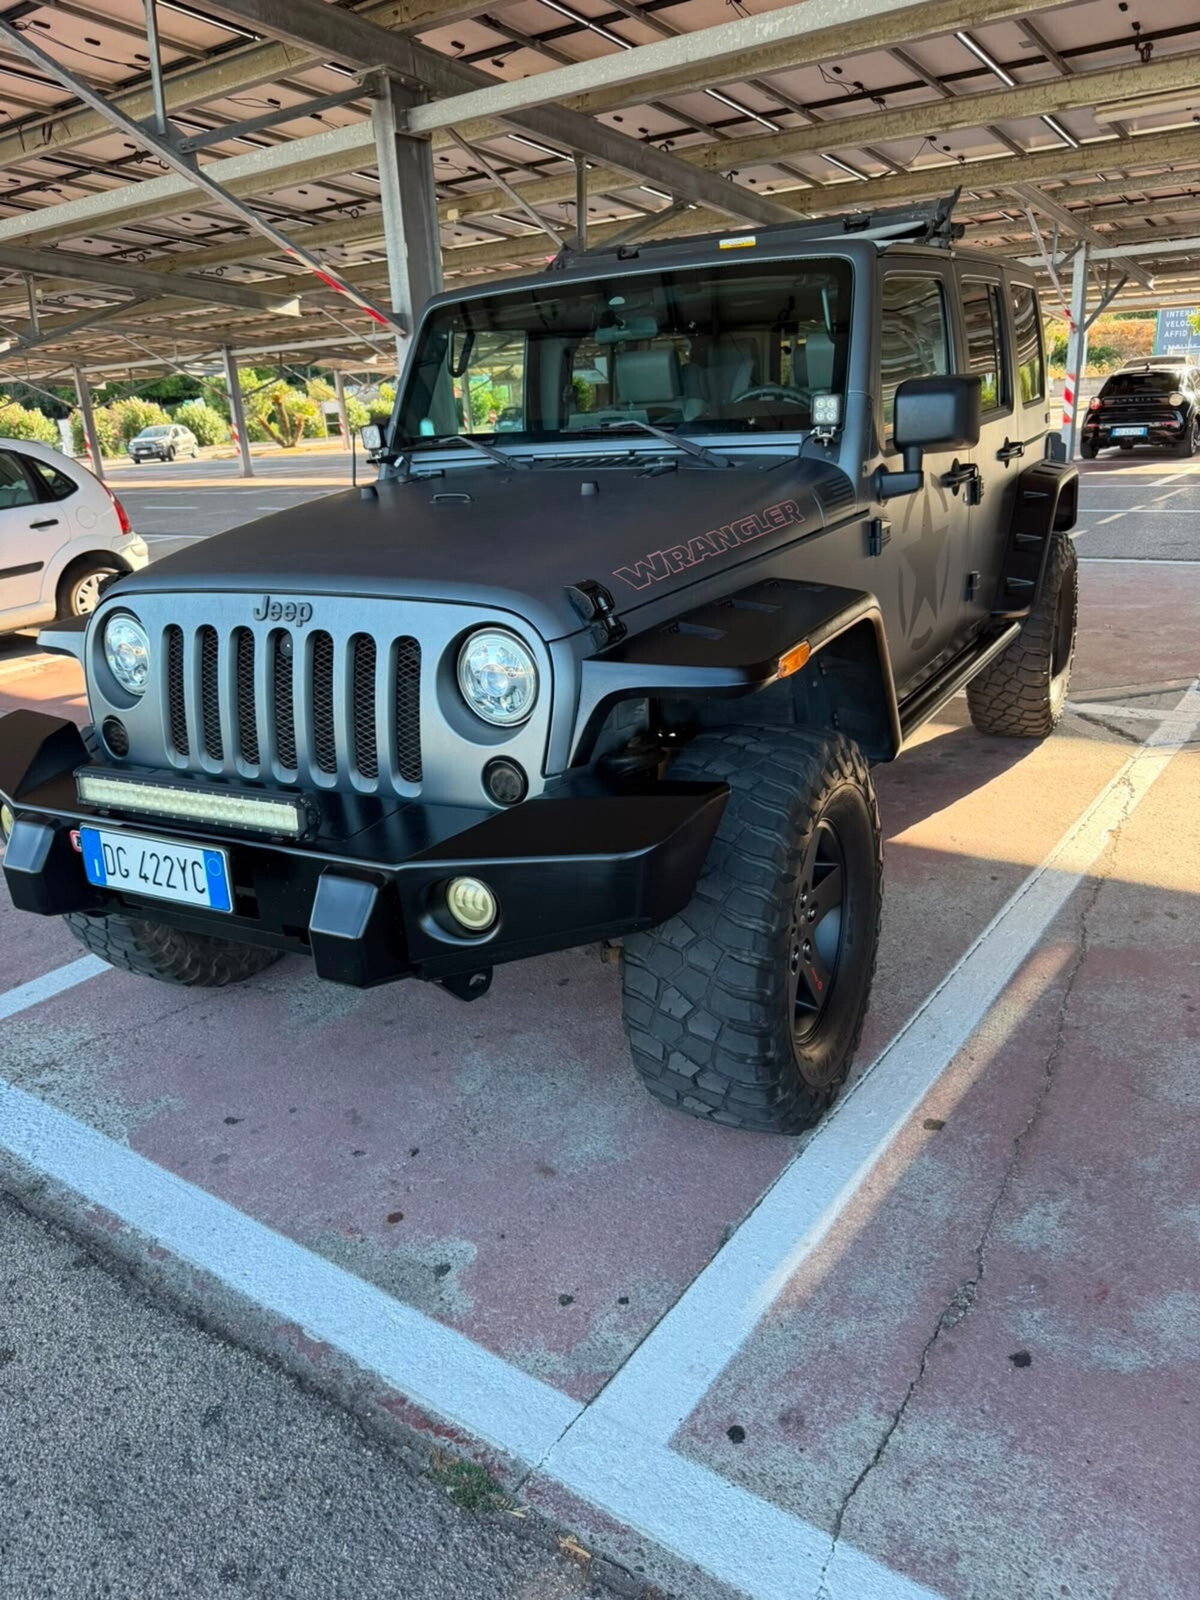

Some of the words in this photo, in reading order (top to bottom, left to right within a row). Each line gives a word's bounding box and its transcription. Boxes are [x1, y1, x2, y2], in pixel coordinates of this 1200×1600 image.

[612, 499, 806, 590] WRANGLER
[253, 595, 313, 627] Jeep
[102, 843, 130, 879] DG
[138, 850, 206, 894] 422YC
